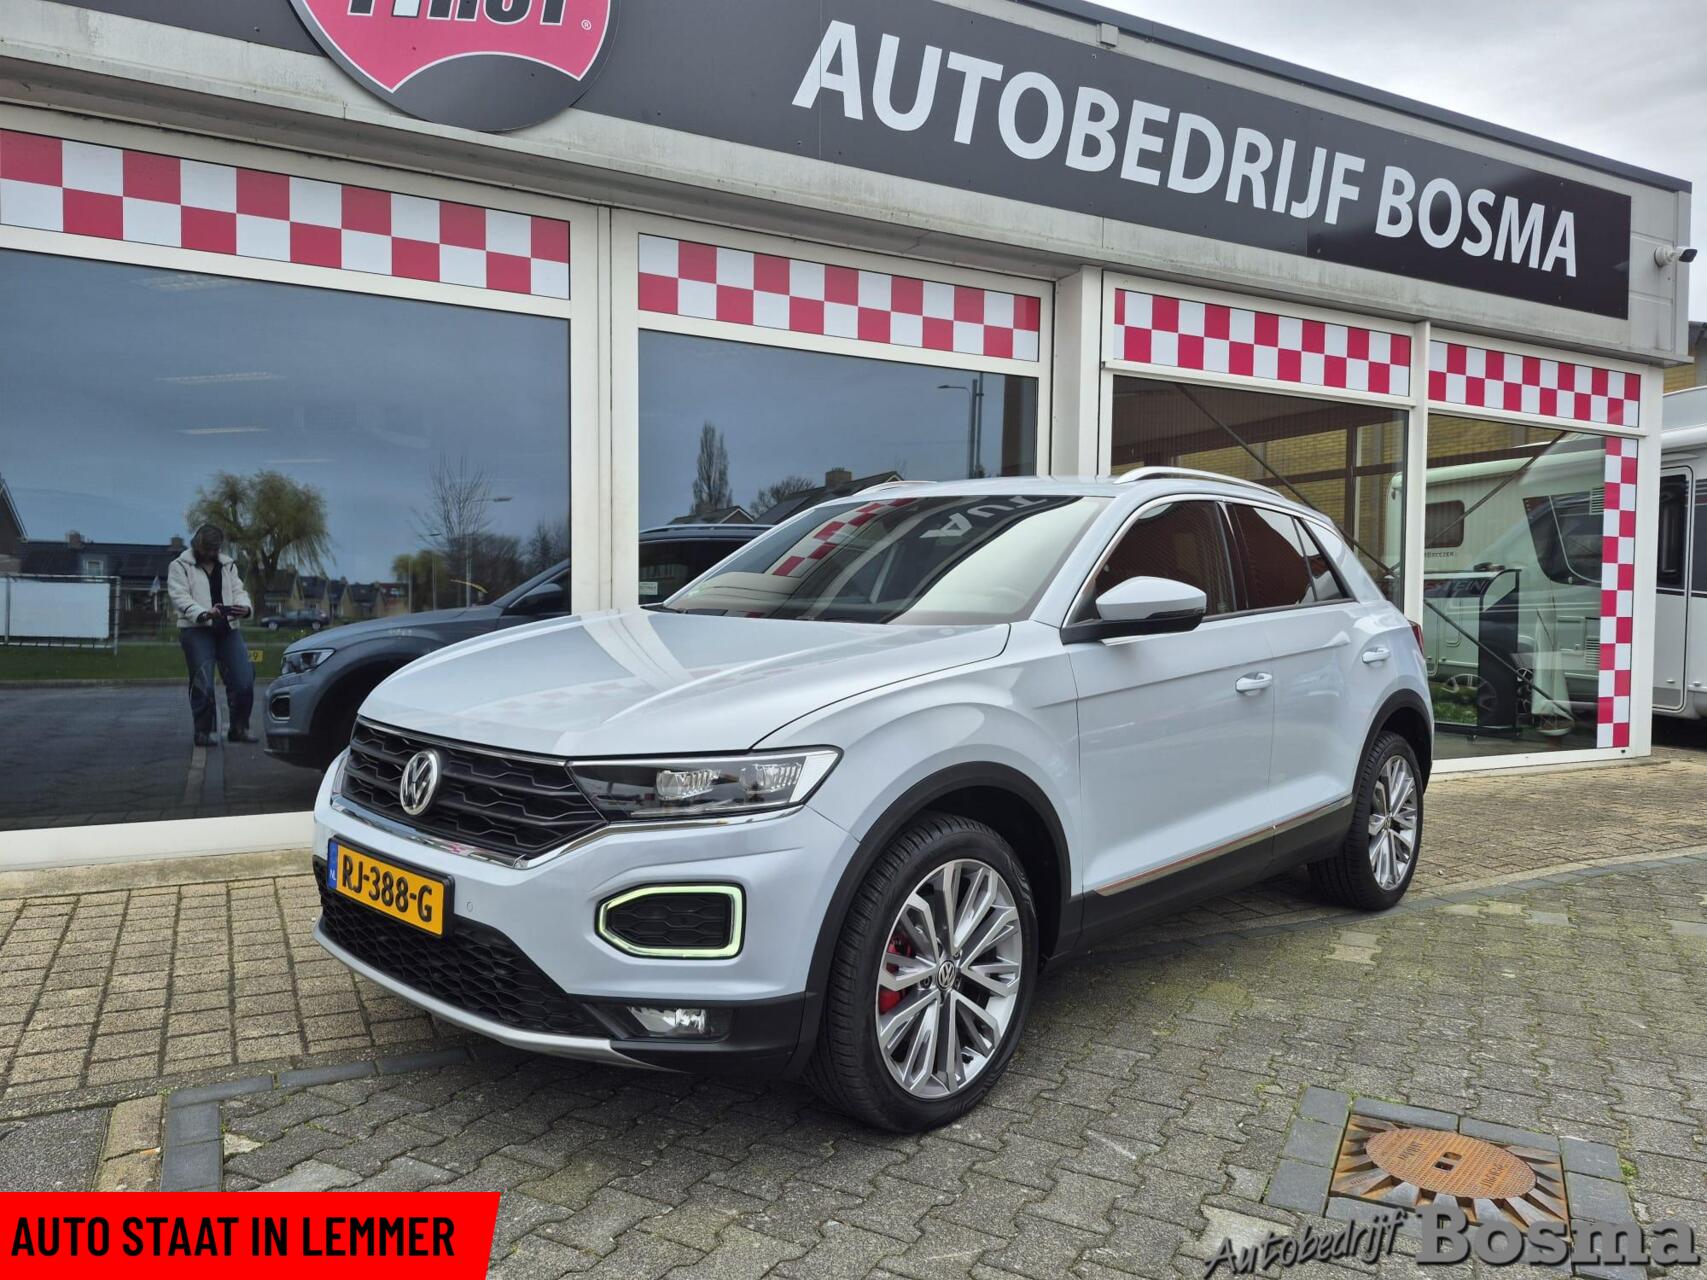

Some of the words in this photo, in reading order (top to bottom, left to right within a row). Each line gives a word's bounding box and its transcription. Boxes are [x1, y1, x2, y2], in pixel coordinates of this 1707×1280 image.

[791, 20, 1365, 225] AUTOBEDRIJF
[1375, 165, 1577, 277] BOSMA
[342, 854, 432, 923] RJ-388-G
